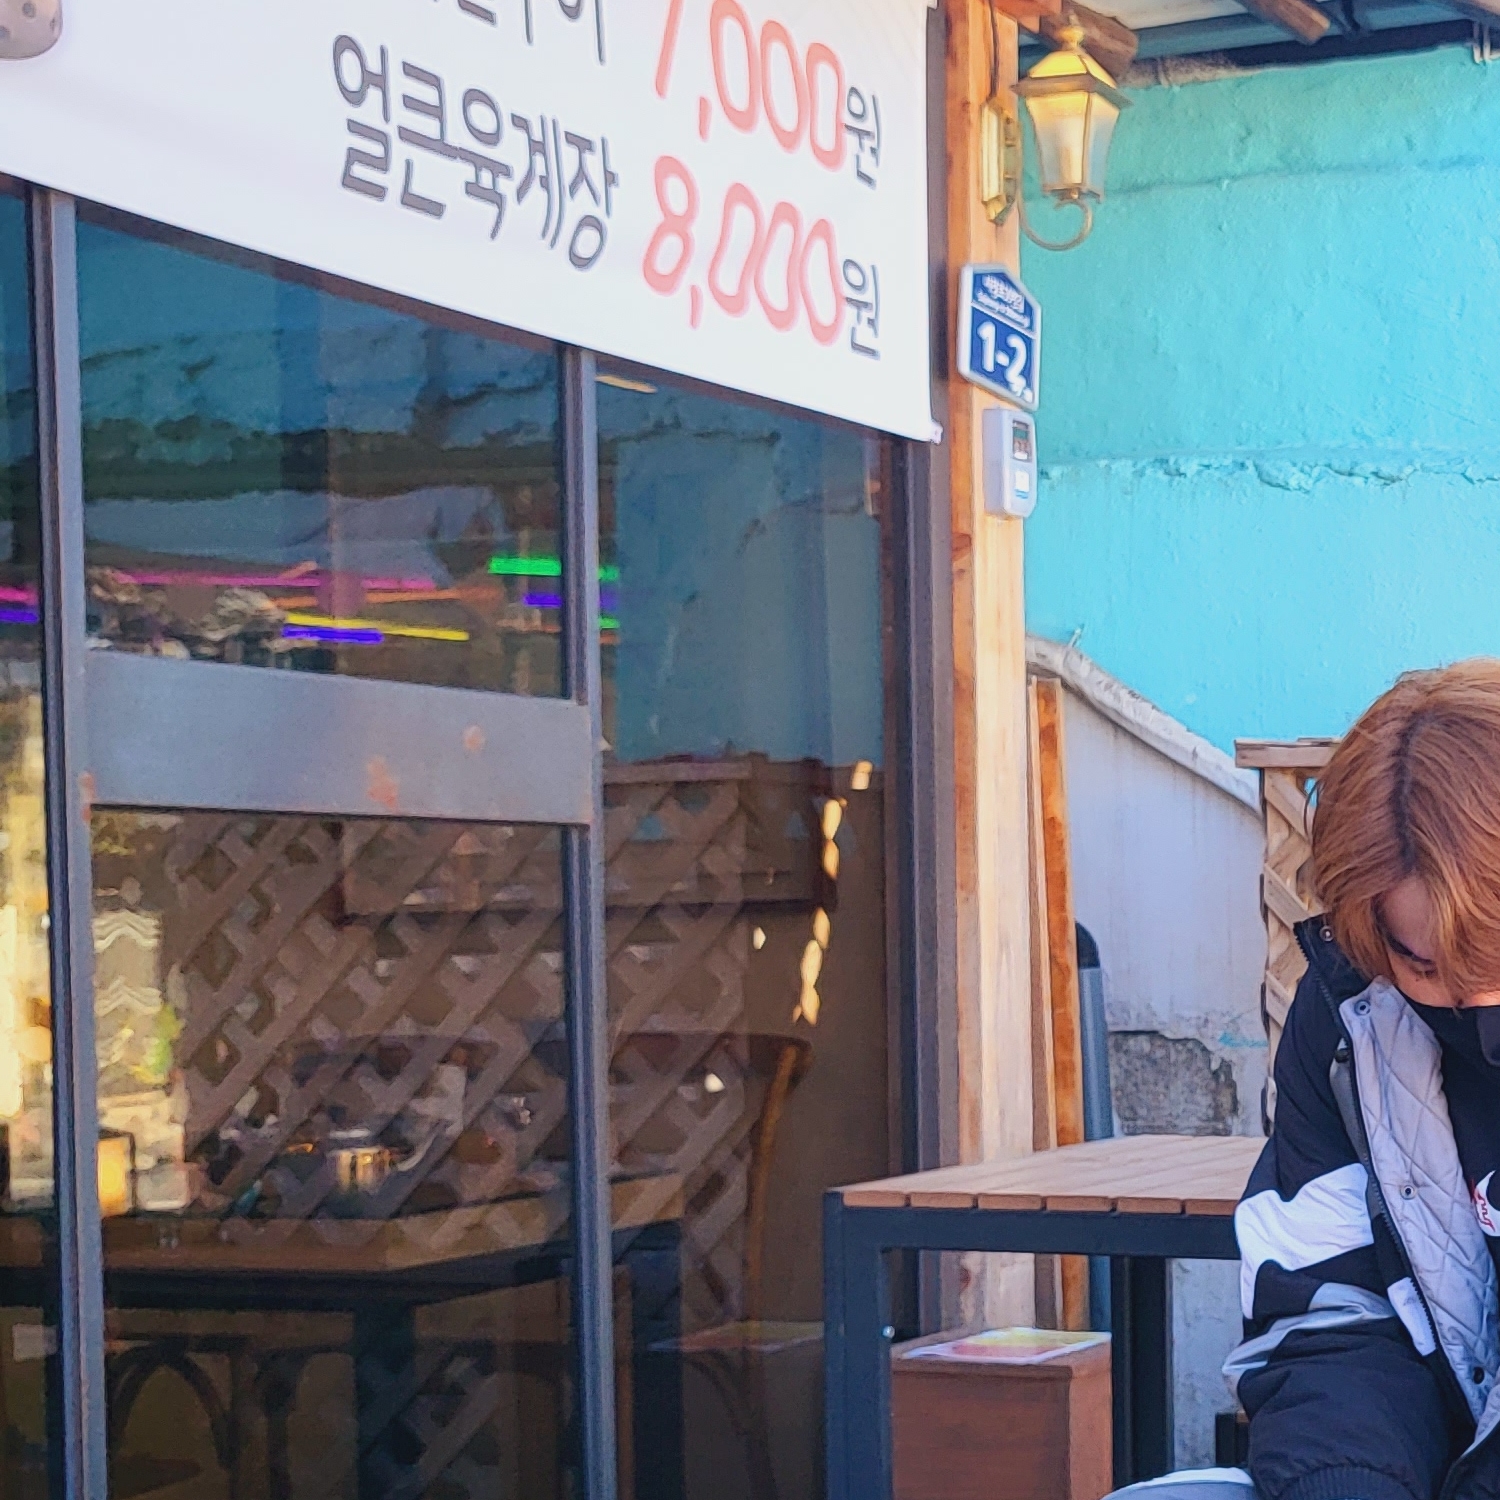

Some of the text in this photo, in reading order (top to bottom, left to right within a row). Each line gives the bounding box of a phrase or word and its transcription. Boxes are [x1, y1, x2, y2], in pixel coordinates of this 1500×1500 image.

[333, 34, 881, 361] 얼큰육계장 8,000원
[977, 321, 1027, 397] 1-2
